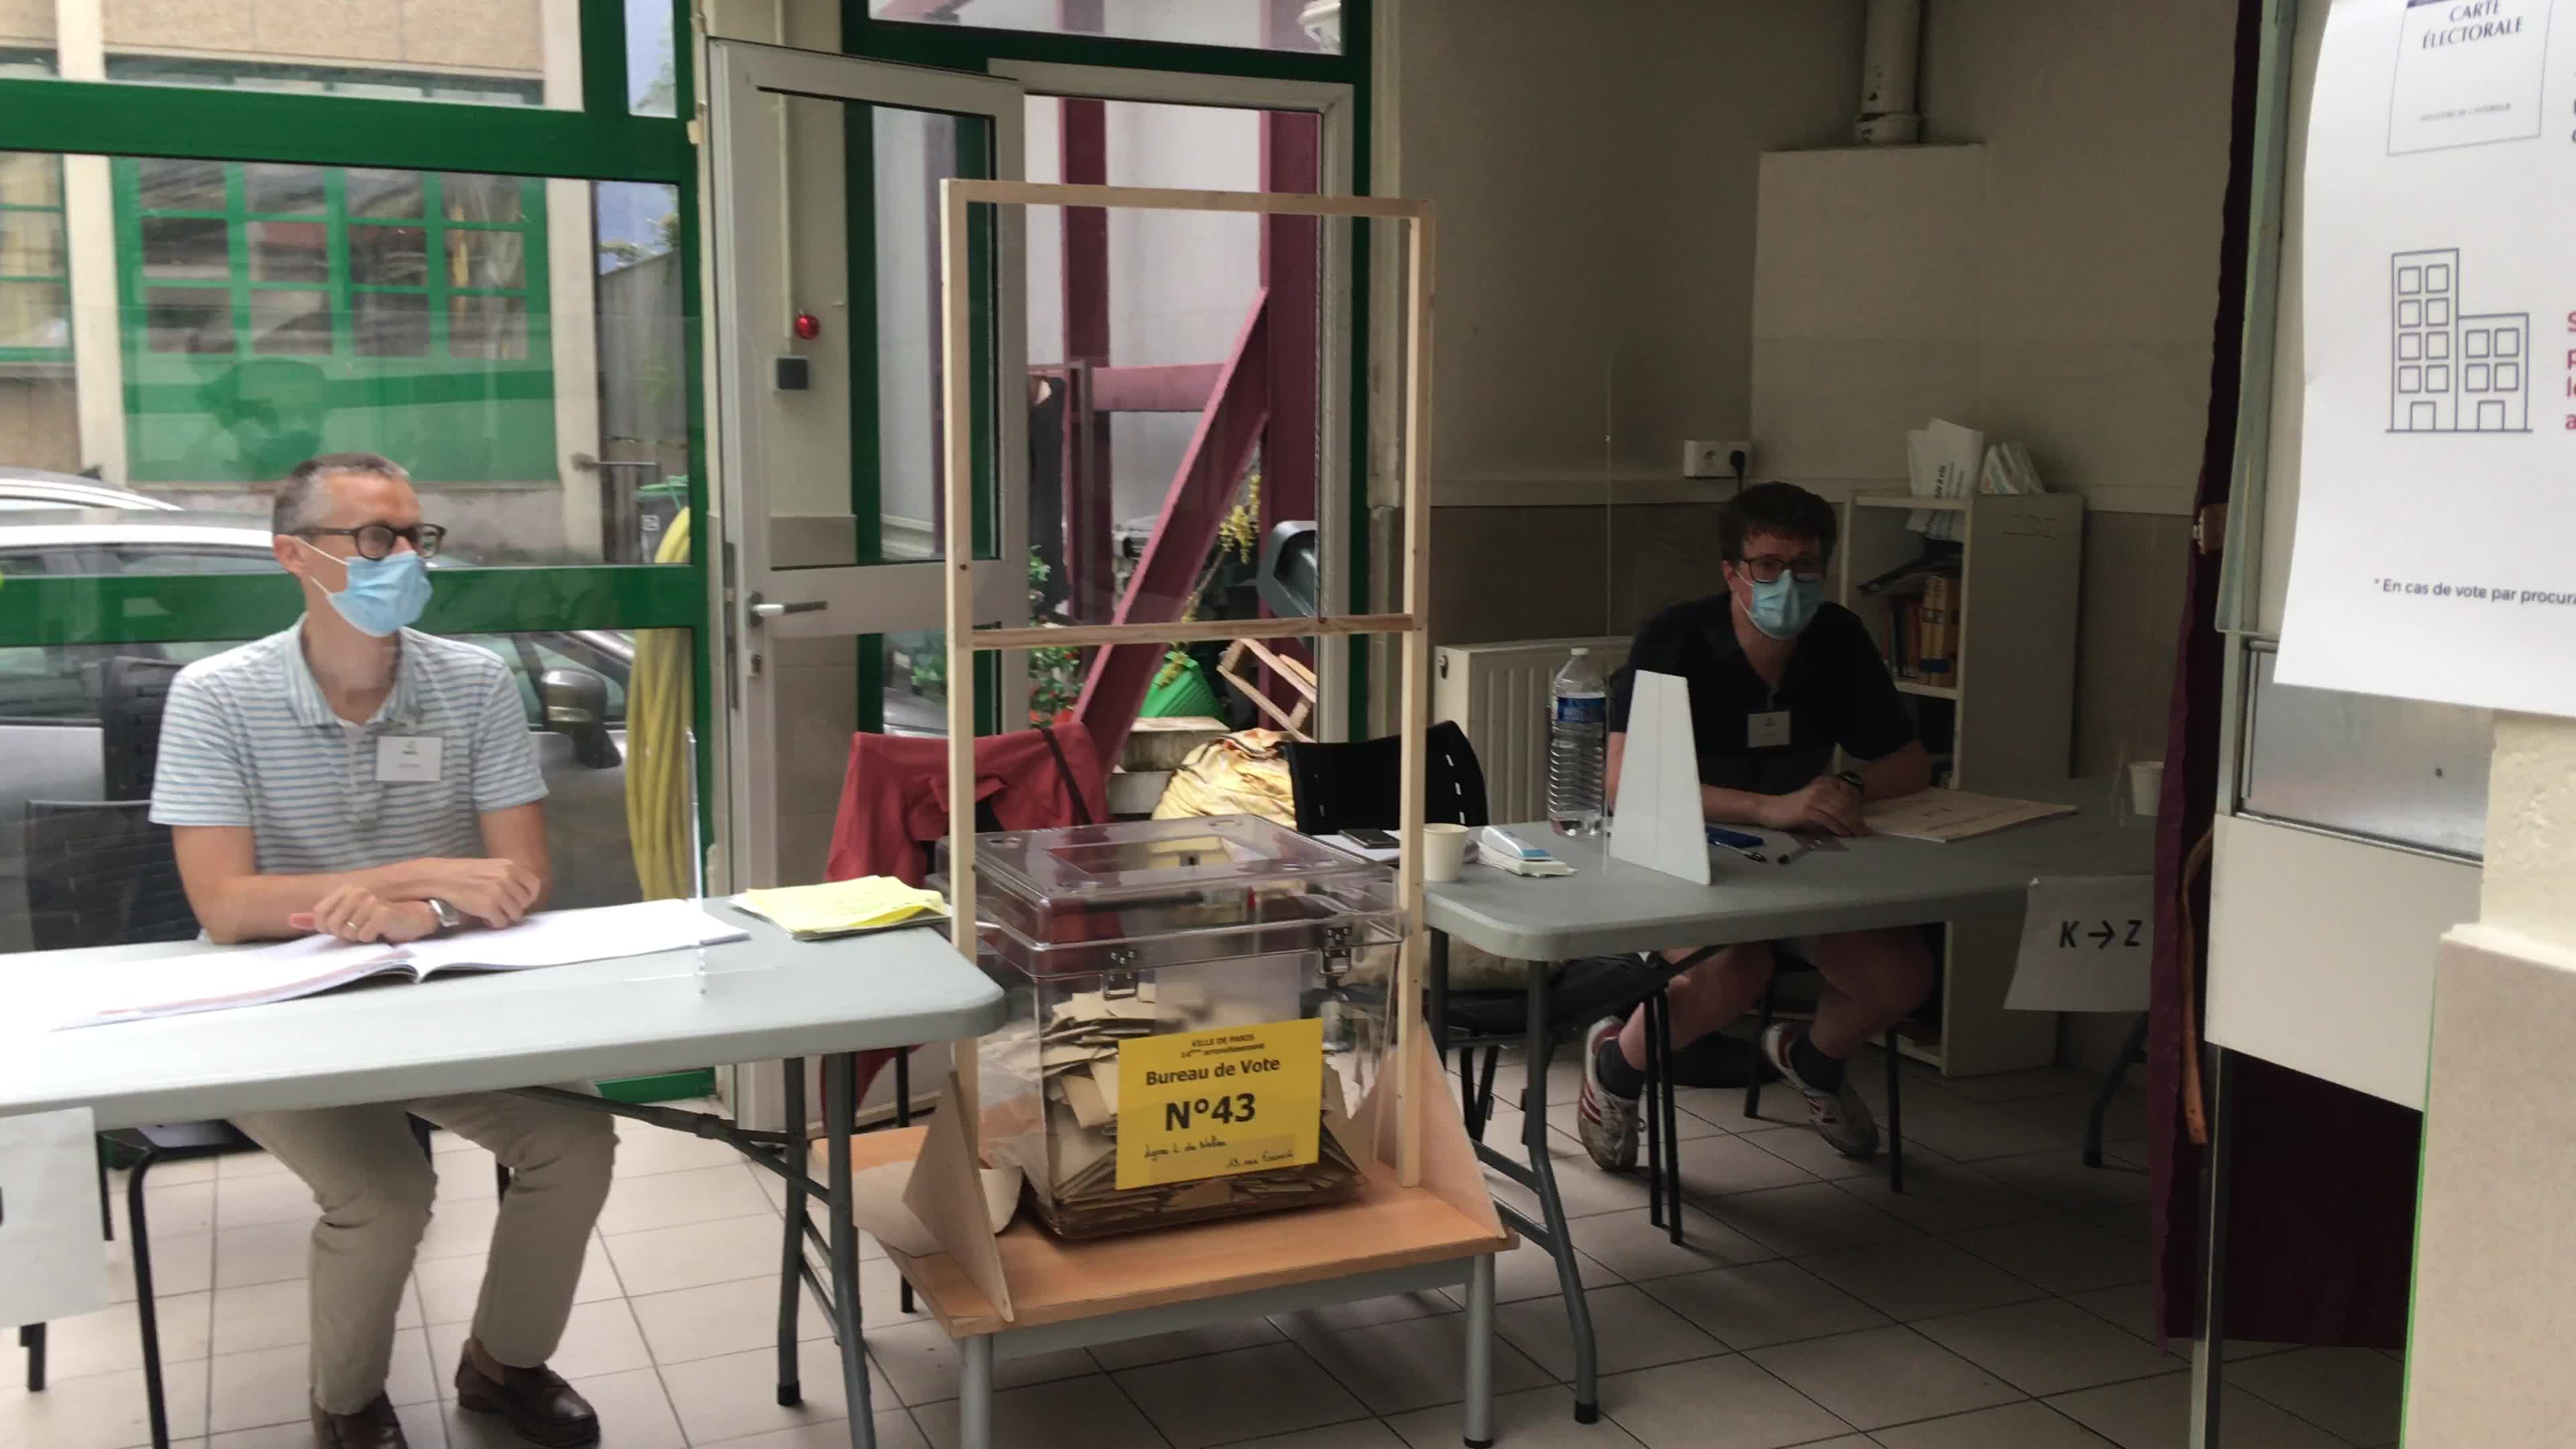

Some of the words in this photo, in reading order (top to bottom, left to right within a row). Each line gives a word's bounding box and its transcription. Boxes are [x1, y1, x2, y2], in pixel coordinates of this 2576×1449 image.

[2450, 0, 2501, 22] CARTE
[2383, 578, 2402, 593] En
[2405, 582, 2429, 595] cas
[2432, 582, 2452, 596] de
[2456, 585, 2487, 599] vote
[2491, 587, 2517, 602] par
[2059, 920, 2080, 948] K
[2124, 919, 2143, 947] Z
[1146, 1067, 1210, 1085] Bureau
[1214, 1063, 1235, 1078] de
[1241, 1057, 1281, 1074] Vote
